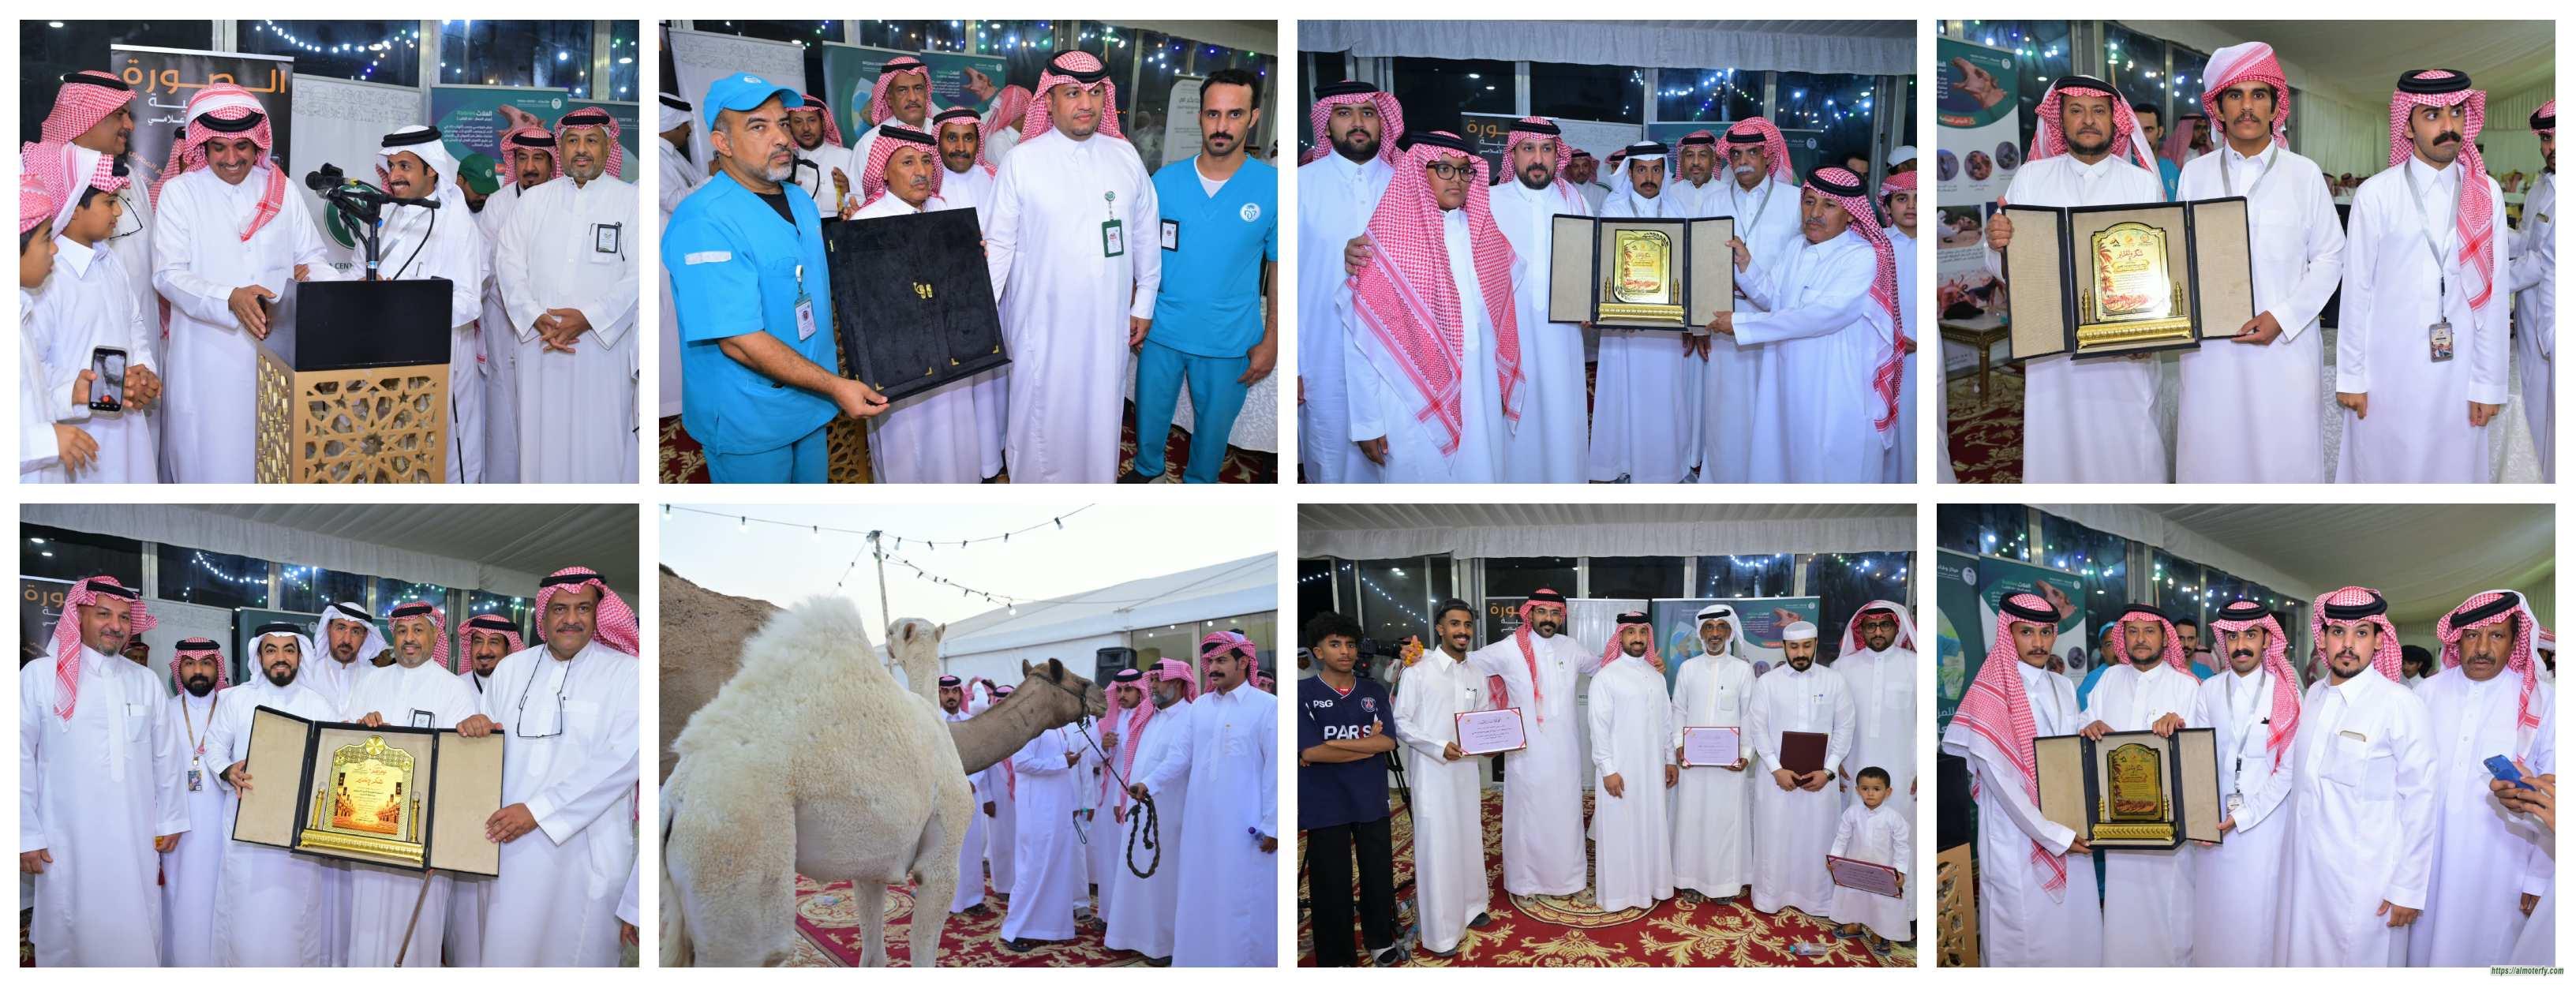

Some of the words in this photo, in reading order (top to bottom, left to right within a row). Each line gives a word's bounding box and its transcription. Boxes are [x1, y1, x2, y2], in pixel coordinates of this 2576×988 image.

[123, 58, 286, 95] الصورة
[1467, 120, 1509, 138] ورة
[24, 584, 63, 608] ورة
[1490, 602, 1521, 618] ورة
[1313, 699, 1334, 709] PSG
